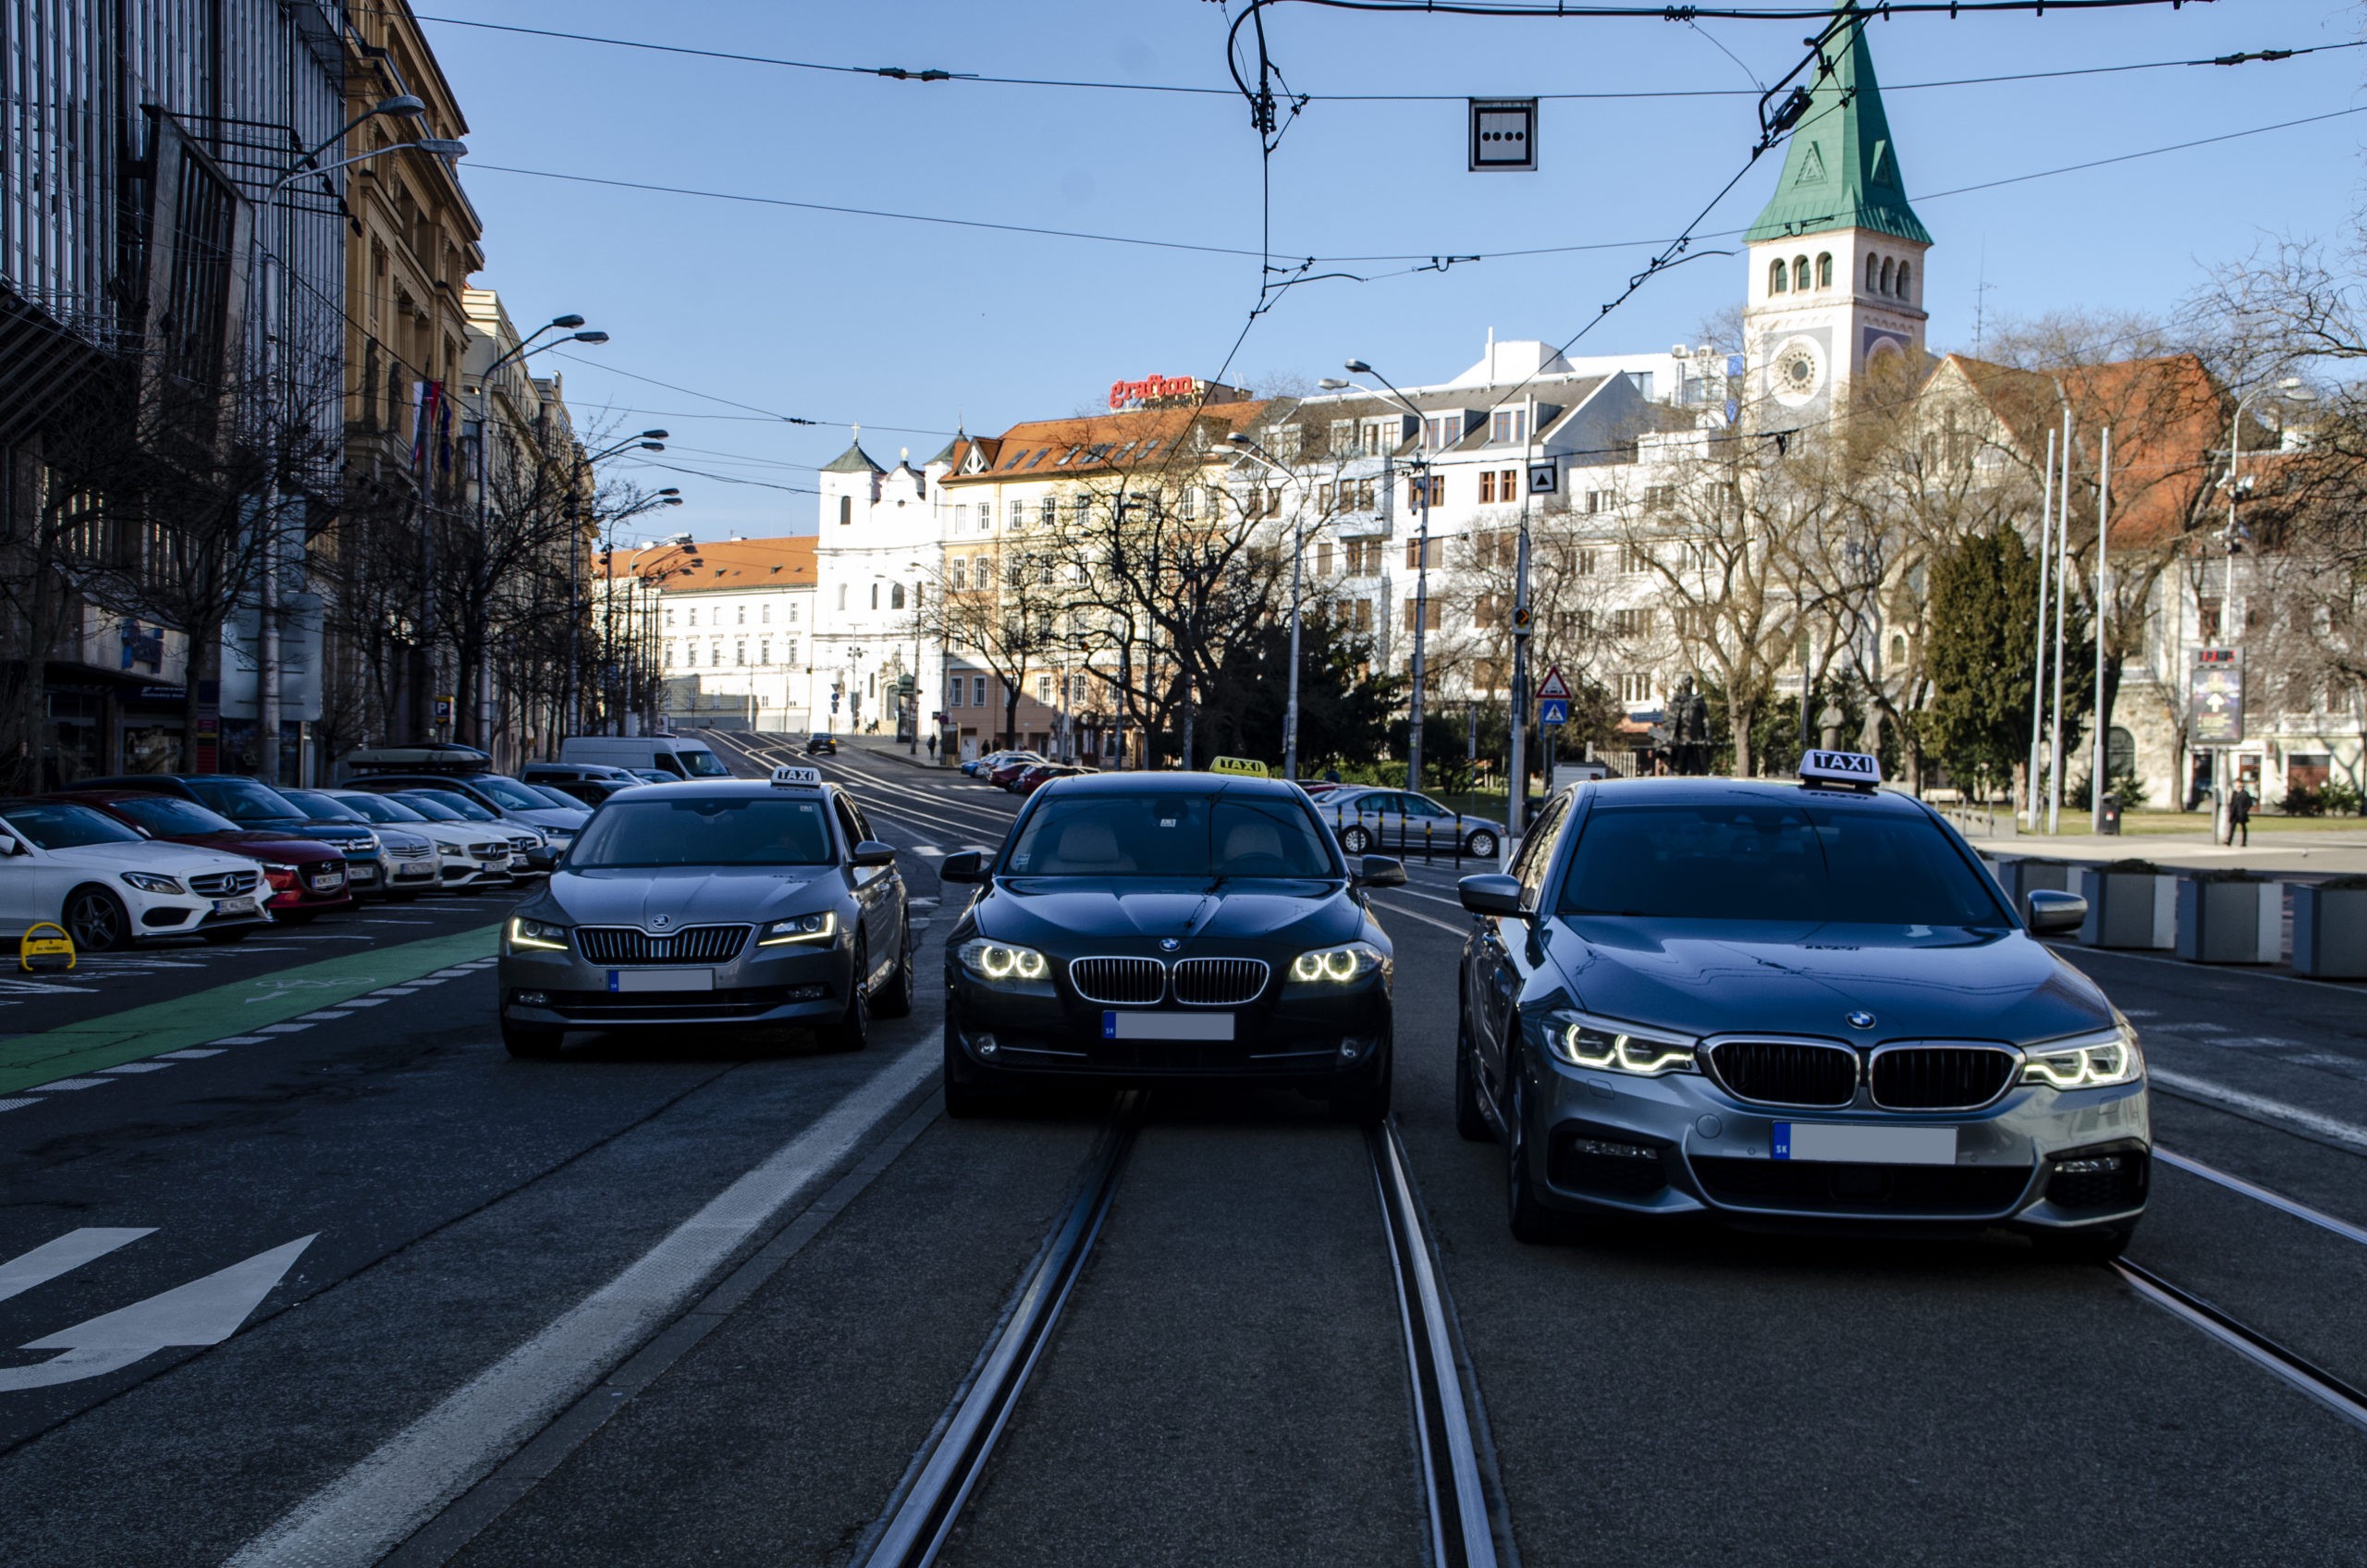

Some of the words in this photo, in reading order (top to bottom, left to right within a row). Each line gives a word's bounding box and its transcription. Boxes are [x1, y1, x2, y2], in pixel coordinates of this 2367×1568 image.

[1110, 374, 1192, 408] grafton
[437, 702, 448, 714] P
[1222, 759, 1259, 771] TAXI
[1816, 753, 1870, 772] TAXI
[779, 769, 812, 781] TAXI
[1776, 1145, 1787, 1154] SK
